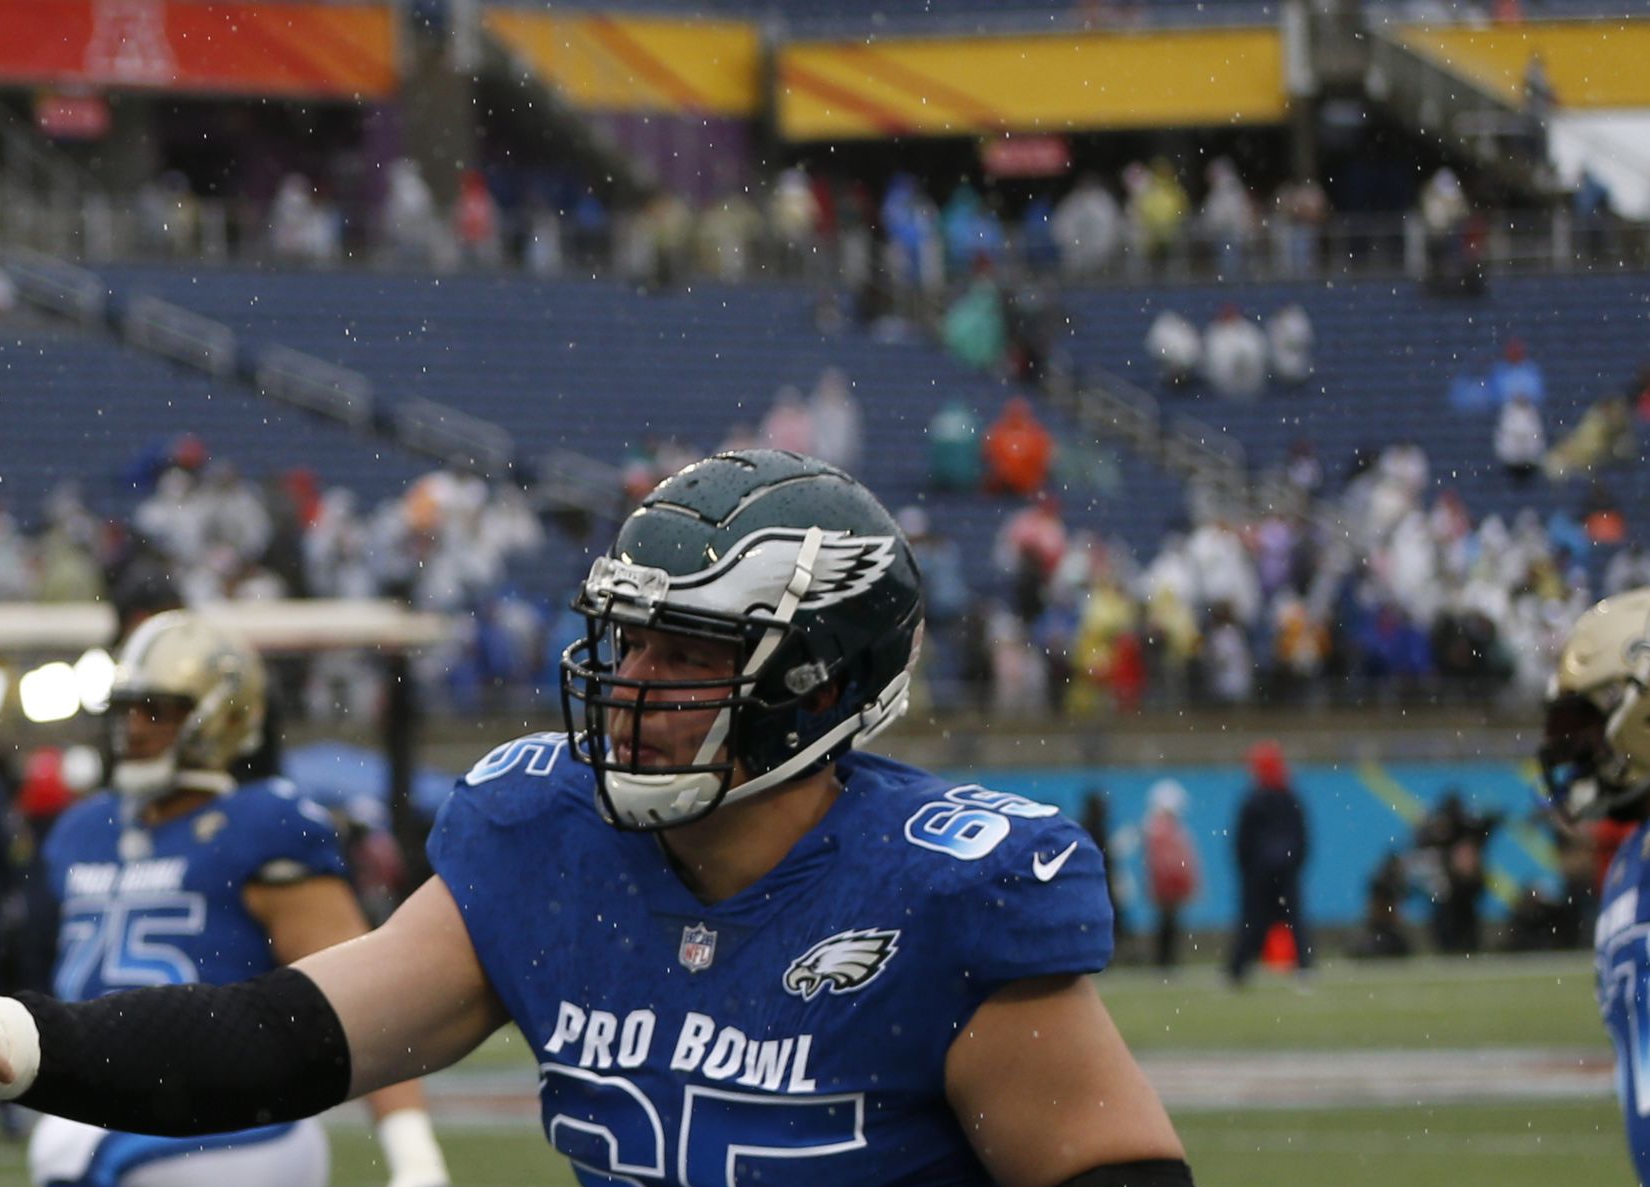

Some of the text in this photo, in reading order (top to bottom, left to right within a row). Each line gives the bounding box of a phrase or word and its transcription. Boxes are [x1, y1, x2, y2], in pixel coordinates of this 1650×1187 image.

[903, 784, 1060, 861] 65
[53, 892, 207, 1004] 75
[544, 1000, 817, 1094] PRO BOWL
